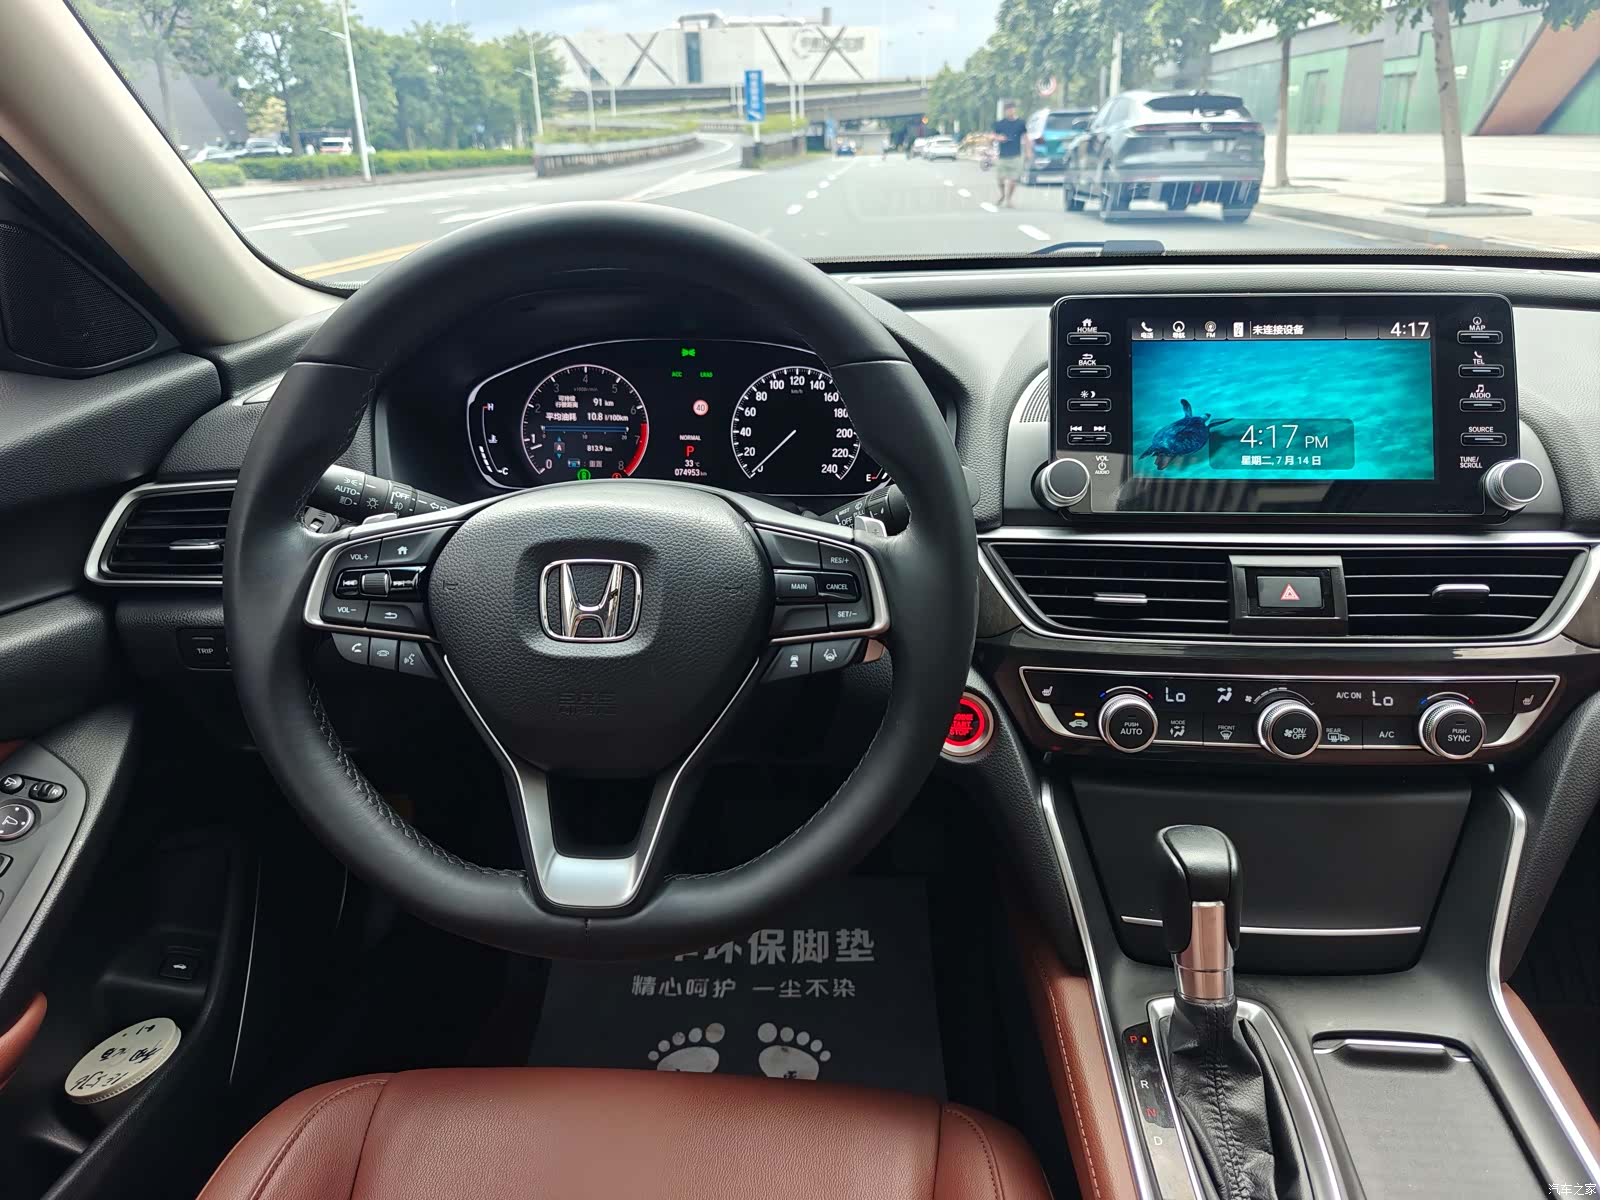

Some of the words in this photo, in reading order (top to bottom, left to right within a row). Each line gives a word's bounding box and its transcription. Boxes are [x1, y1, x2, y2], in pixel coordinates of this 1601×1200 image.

[1077, 326, 1098, 334] HOME
[1252, 324, 1304, 336] 未连接设备
[1390, 321, 1429, 337] 4:17
[1469, 324, 1486, 332] MAP
[582, 374, 589, 384] 4
[789, 376, 806, 387] 120
[553, 383, 560, 393] 3
[612, 383, 618, 394] 5
[769, 379, 785, 391] 100
[809, 380, 826, 392] 140
[755, 391, 768, 402] 80
[823, 391, 840, 403] 160
[487, 403, 494, 411] H
[593, 398, 603, 407] 91
[534, 403, 541, 414] 2
[630, 405, 637, 415] 6
[696, 404, 705, 412] 40
[744, 406, 757, 417] 60
[833, 407, 849, 419] 180
[587, 412, 604, 422] 10.8
[740, 426, 752, 438] 40
[836, 428, 853, 439] 200
[1240, 424, 1299, 449] 4:17
[1304, 435, 1329, 449] PM
[530, 433, 536, 444] 1
[634, 435, 640, 445] 7
[686, 445, 694, 457] P
[743, 446, 756, 457] 20
[831, 448, 849, 459] 220
[545, 459, 553, 470] 0
[618, 460, 625, 471] 8
[684, 459, 694, 468] 33
[502, 467, 509, 475] C
[674, 469, 700, 477] 074953
[821, 463, 838, 475] 240
[865, 473, 872, 482] E
[334, 484, 357, 496] AUTO
[395, 491, 410, 500] OFF
[841, 515, 853, 526] OFF
[1336, 691, 1349, 700] A/C
[1350, 691, 1362, 699] ON
[1120, 727, 1143, 737] AUTO
[1292, 727, 1307, 735] ON/
[1379, 731, 1395, 739] A/C
[1447, 734, 1471, 743] SYNC
[51, 788, 59, 796] R
[631, 974, 736, 999] 精心呵护
[752, 977, 856, 998] 一尘不染
[1129, 1034, 1138, 1044] P
[1140, 1080, 1150, 1089] R
[1146, 1107, 1158, 1117] N
[1153, 1136, 1163, 1146] D
